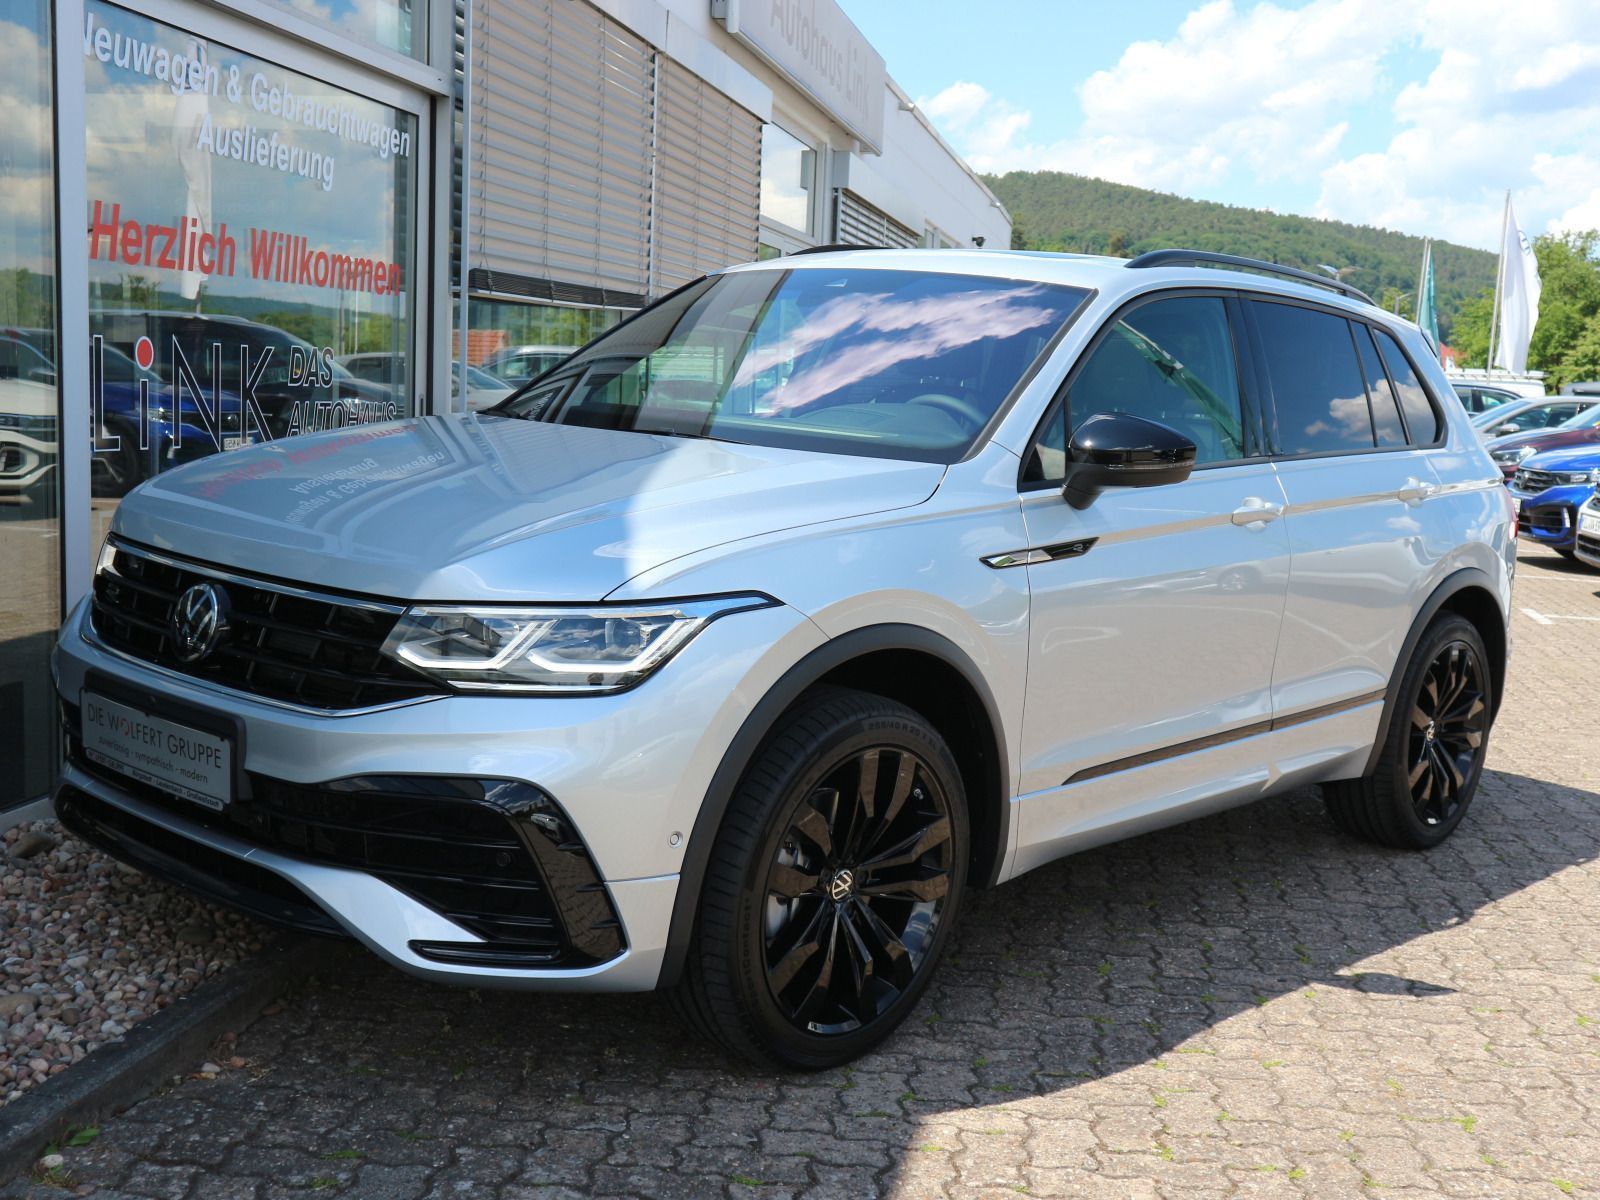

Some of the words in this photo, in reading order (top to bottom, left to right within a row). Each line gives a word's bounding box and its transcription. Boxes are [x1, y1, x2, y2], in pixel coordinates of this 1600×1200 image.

[226, 64, 241, 104] &
[251, 73, 410, 158] Gebrauchtwagen
[198, 113, 335, 191] Auslieferung
[90, 200, 235, 277] Herzlich
[249, 228, 401, 296] Willkommen
[287, 345, 334, 388] DAS
[87, 703, 105, 727] DIE
[108, 712, 163, 749] WOLFERT
[167, 734, 221, 768] GRUPPE
